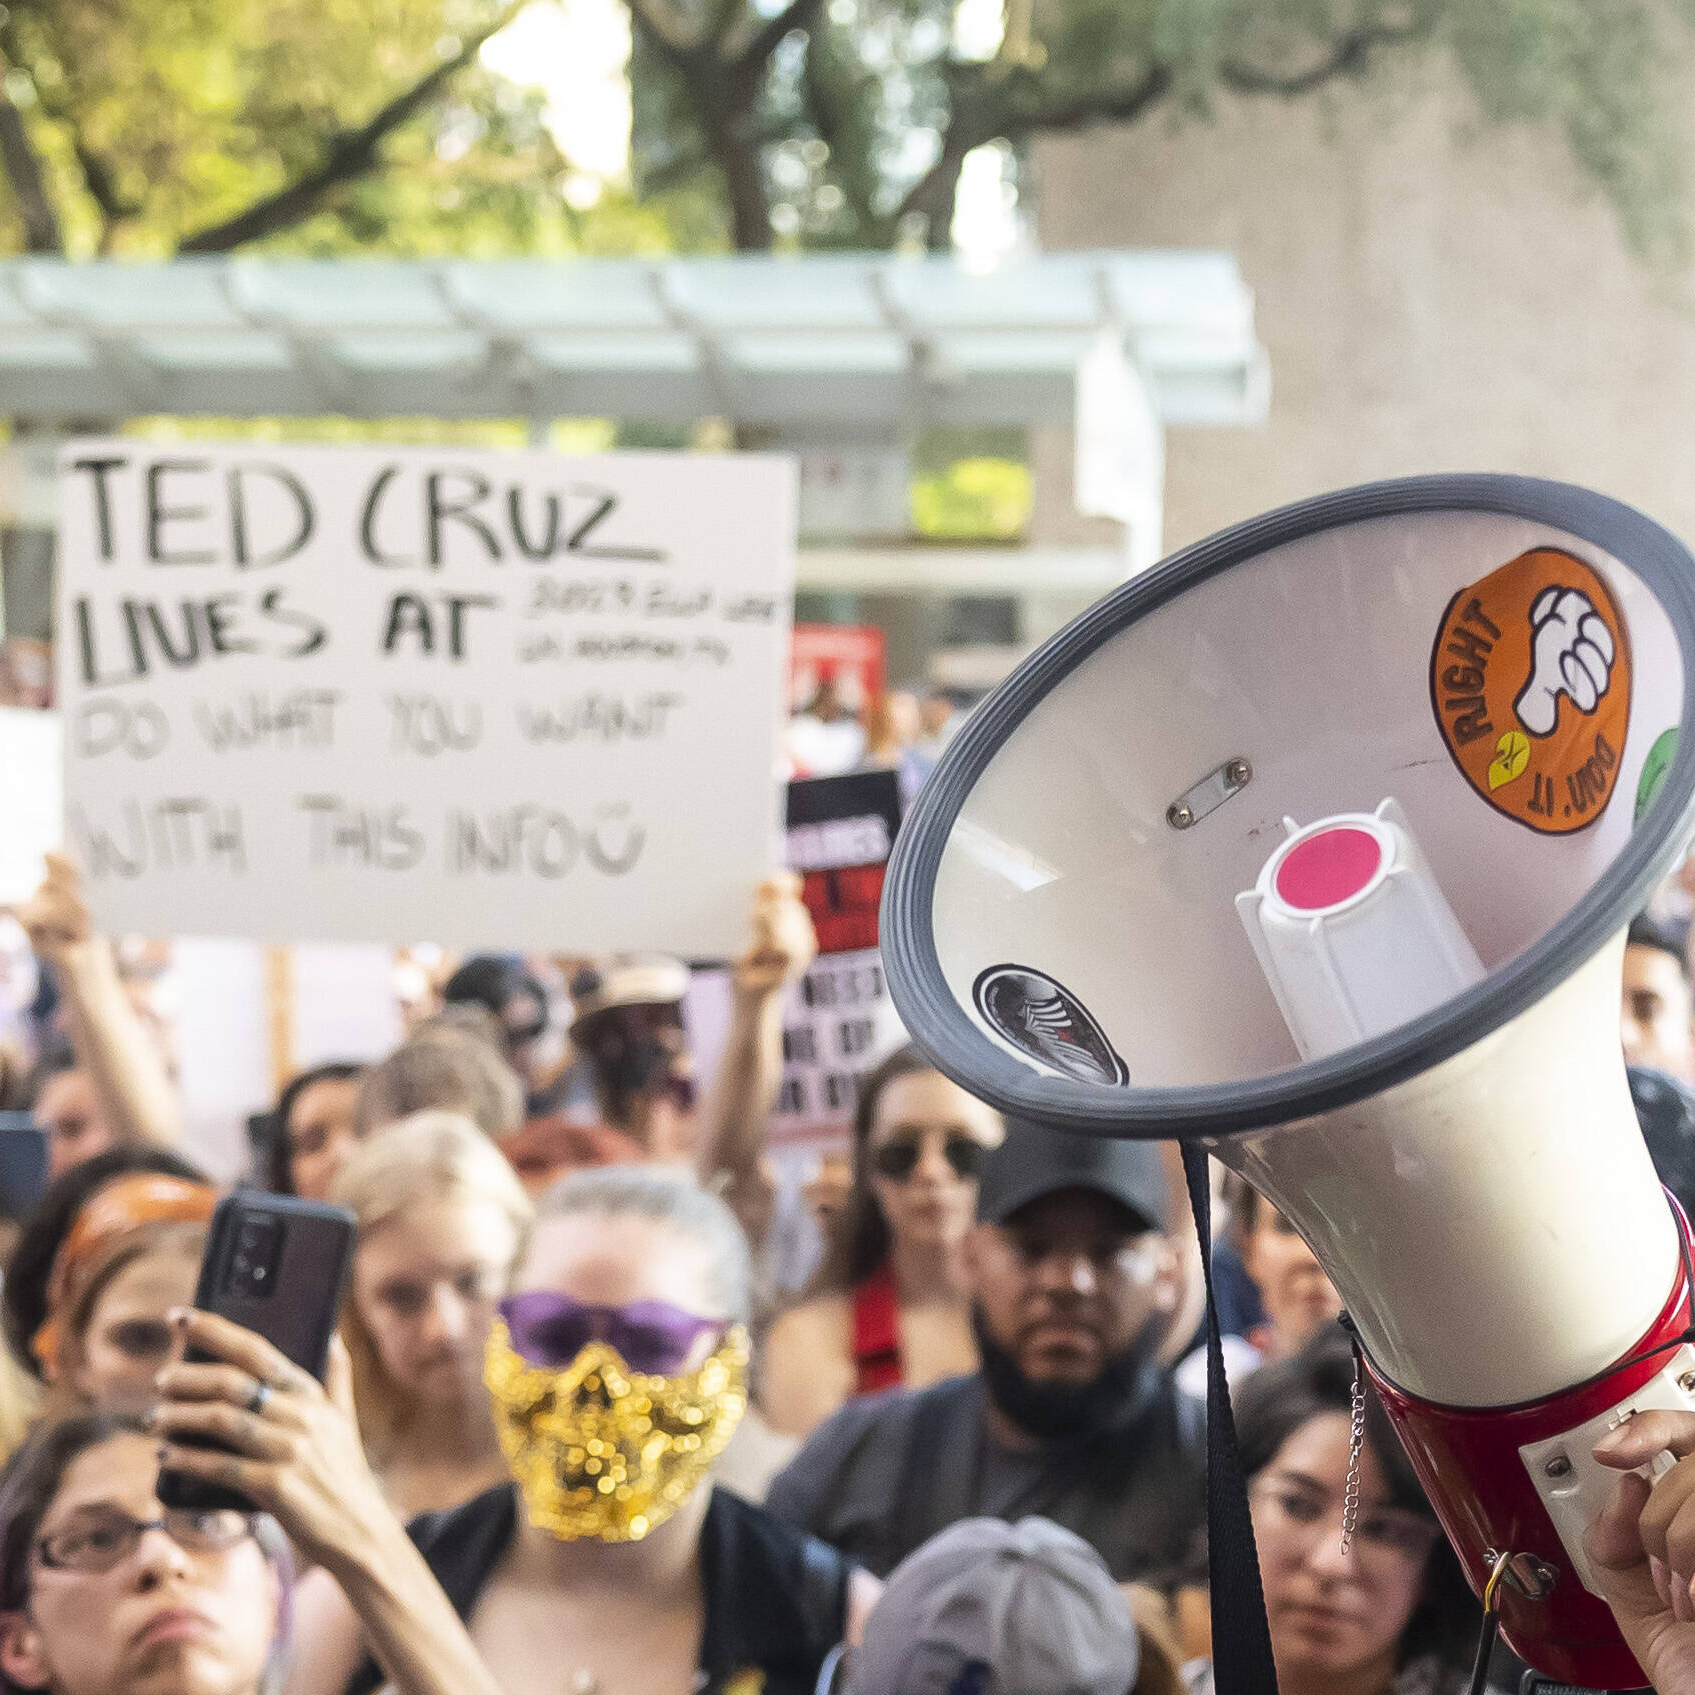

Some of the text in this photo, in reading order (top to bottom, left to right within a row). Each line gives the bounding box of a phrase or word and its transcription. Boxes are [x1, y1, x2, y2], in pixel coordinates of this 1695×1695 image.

[72, 457, 669, 572] TED CRUZ
[71, 583, 329, 690] LIVES
[376, 587, 500, 664] AT
[1441, 598, 1503, 750] RIGHT
[73, 686, 689, 762] DO WHAT YOU WANT
[70, 796, 251, 880] WITH
[293, 792, 427, 873] THIS
